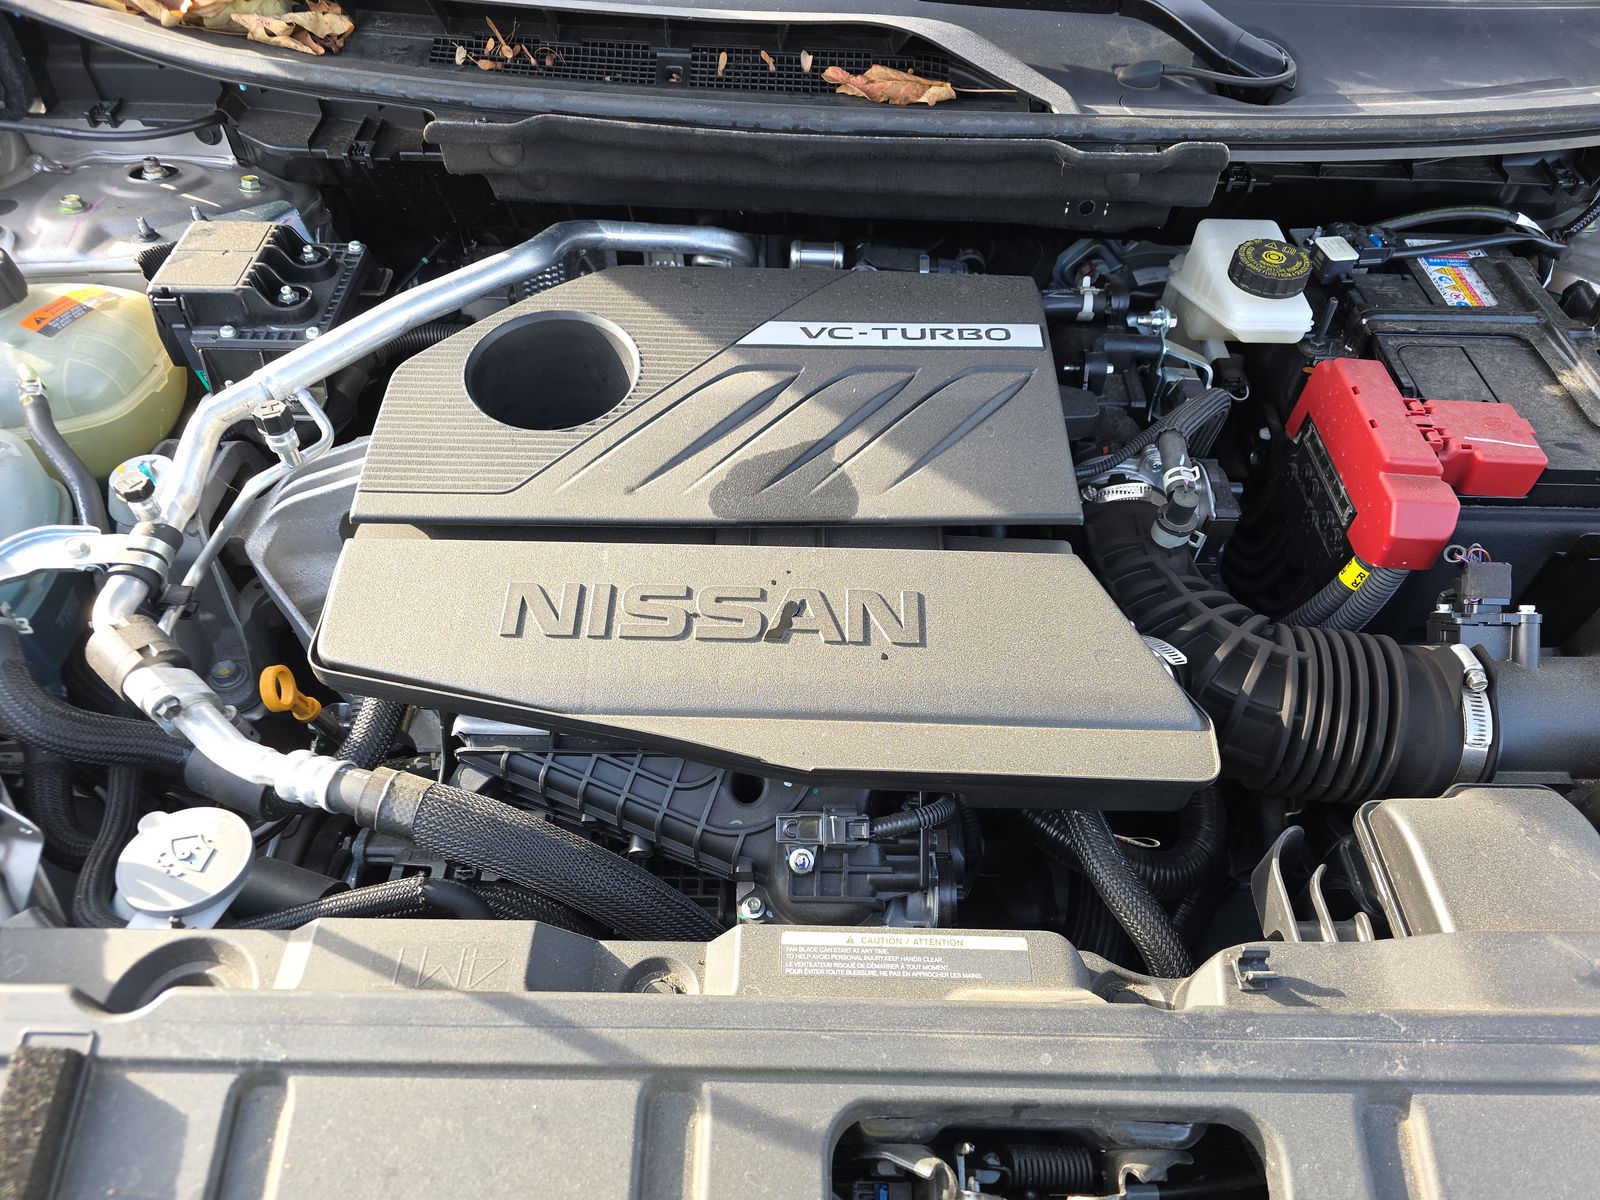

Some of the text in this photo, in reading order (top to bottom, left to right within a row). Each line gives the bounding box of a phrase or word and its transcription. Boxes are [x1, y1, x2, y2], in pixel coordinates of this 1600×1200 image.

[800, 326, 1012, 342] VC-TURBO
[499, 581, 927, 648] NISSAN
[861, 937, 902, 945] CAUTION
[913, 938, 964, 946] ATTENTION
[866, 961, 899, 970] DÉMARRER
[803, 967, 824, 975] ÉVITER
